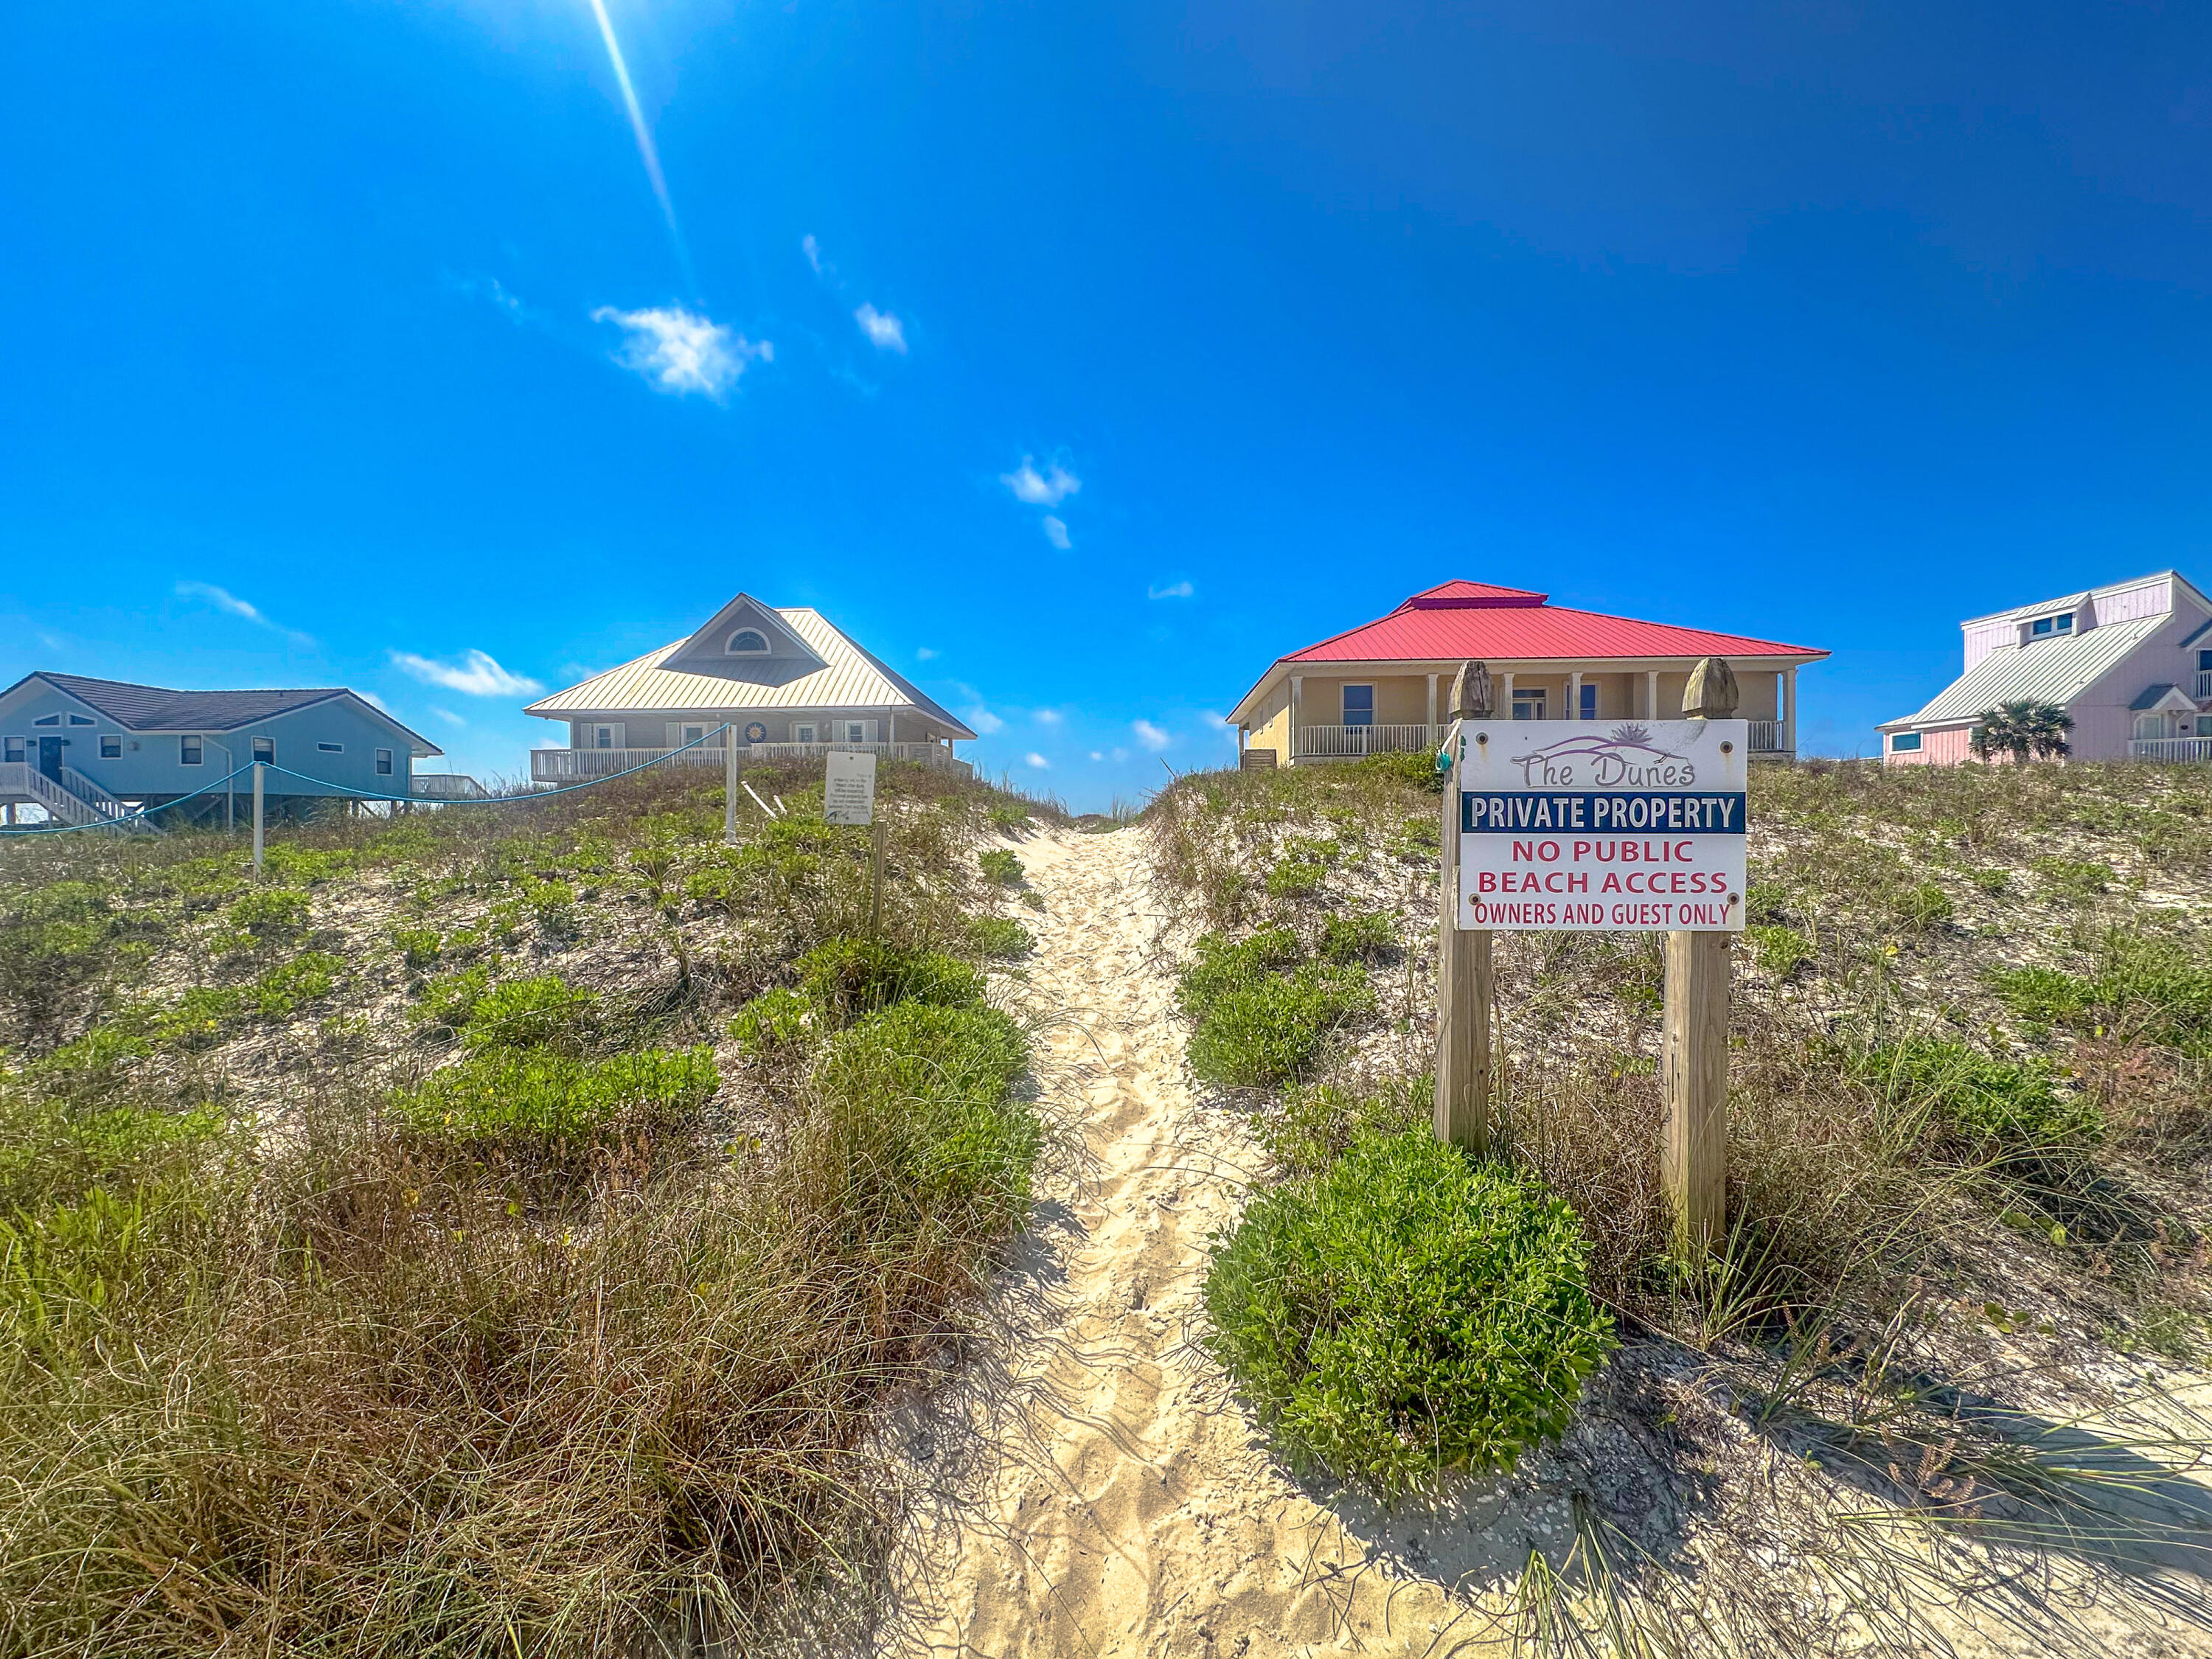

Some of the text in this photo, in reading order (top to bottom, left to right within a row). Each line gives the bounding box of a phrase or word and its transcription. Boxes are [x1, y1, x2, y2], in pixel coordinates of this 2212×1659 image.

[1510, 753, 1695, 787] The Dunes
[1471, 797, 1736, 828] PRIVATE PROPERTY
[1512, 840, 1694, 863] NO PUBLIC
[1478, 872, 1728, 894] BEACH ACCESS
[1474, 902, 1731, 925] OWNERS AND GUEST ONLY
